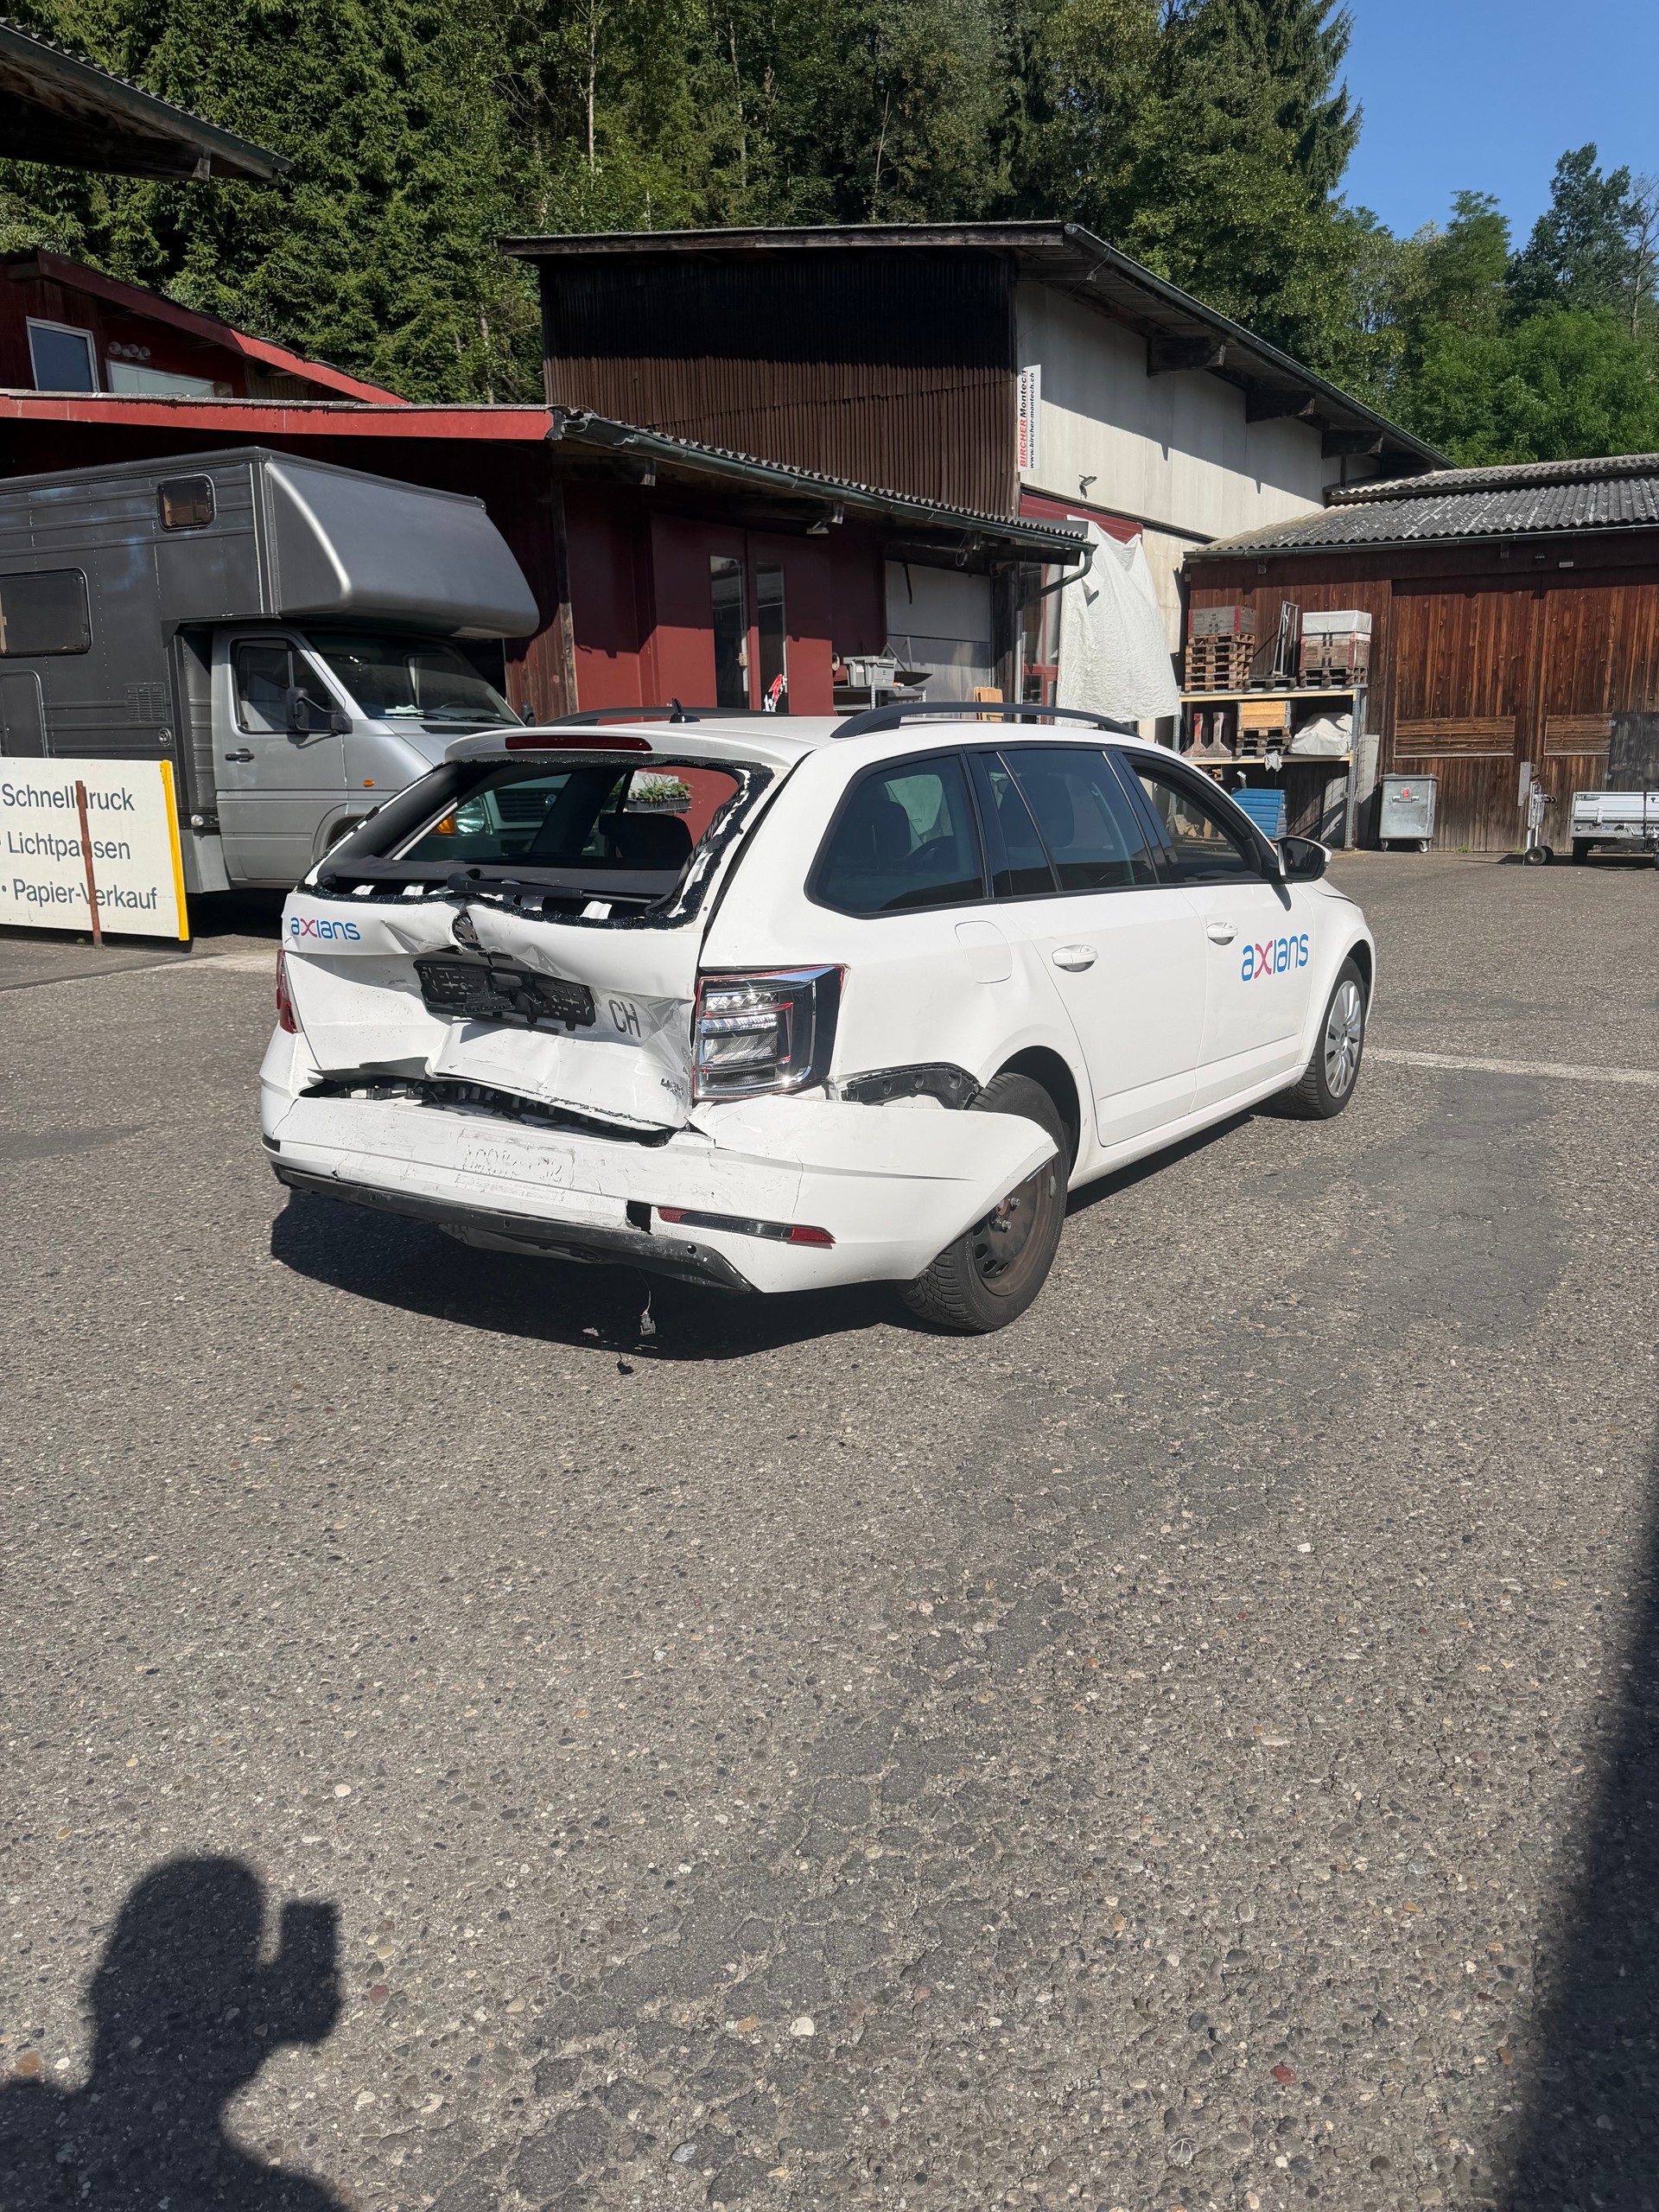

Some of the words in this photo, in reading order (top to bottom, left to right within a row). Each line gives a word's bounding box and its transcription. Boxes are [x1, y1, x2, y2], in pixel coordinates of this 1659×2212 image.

[290, 917, 361, 941] axians
[1242, 933, 1309, 982] axians
[608, 999, 641, 1038] CH
